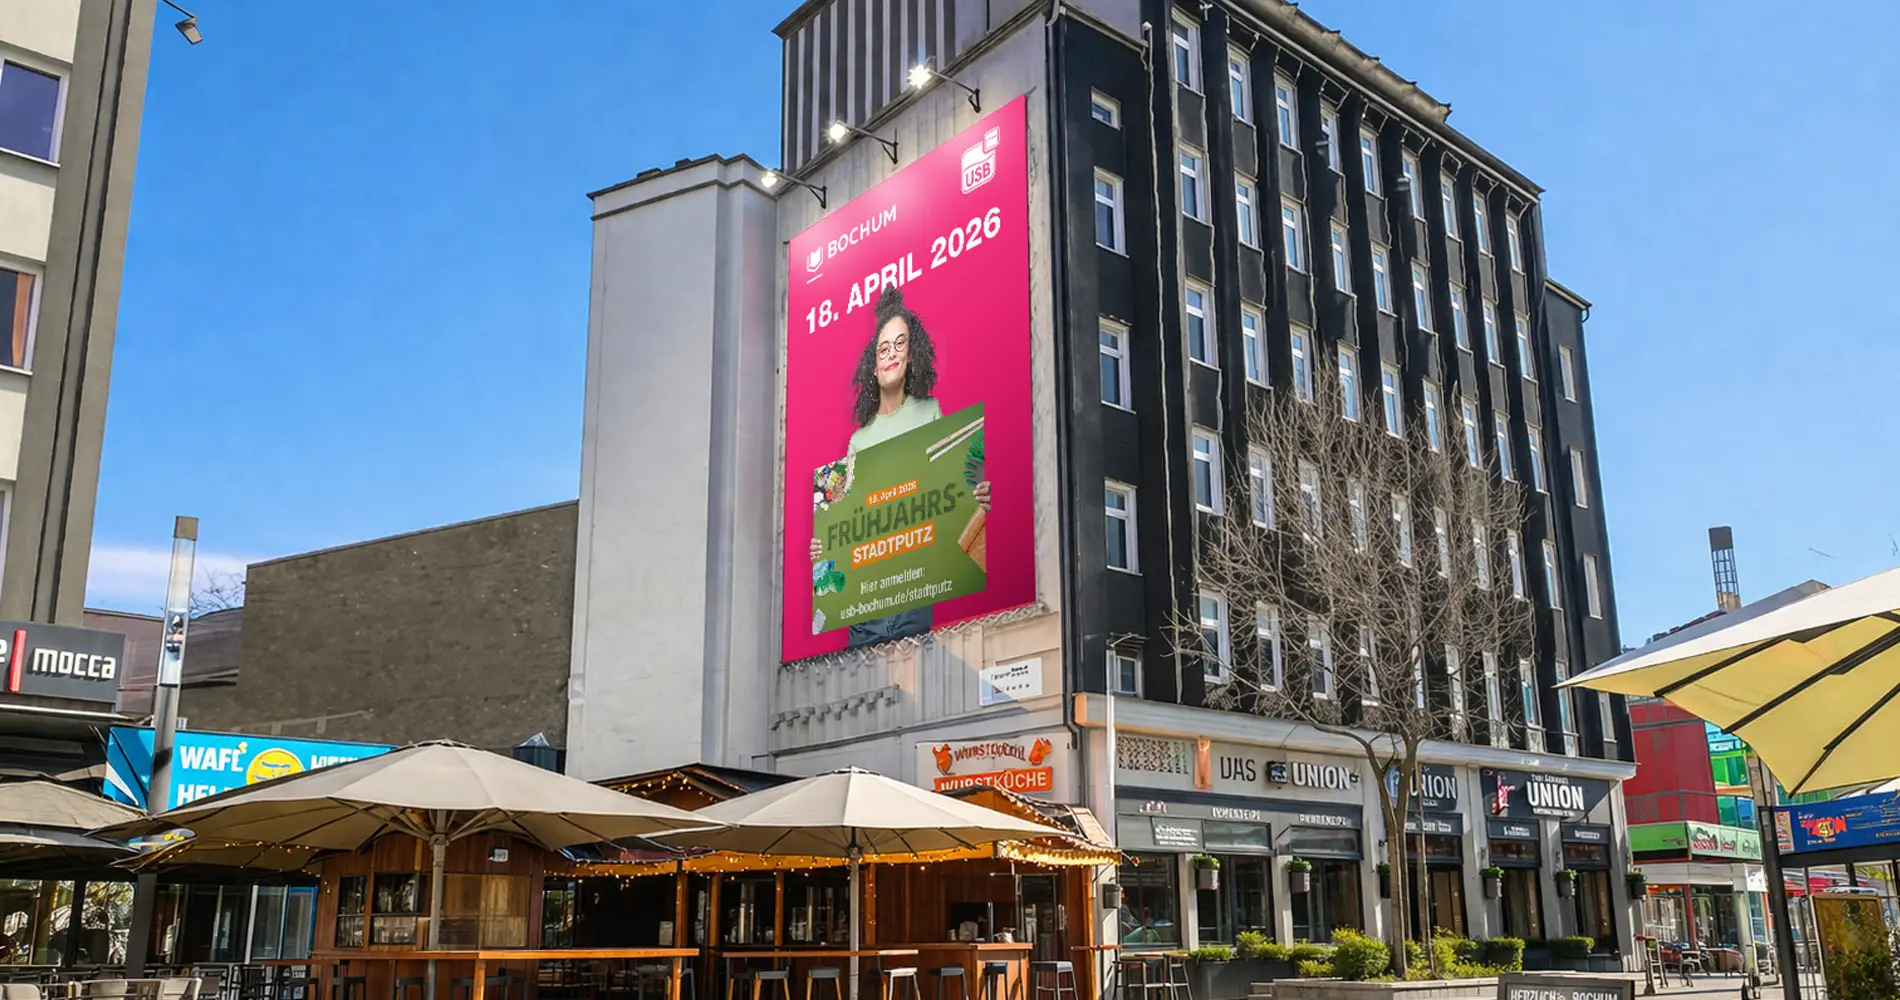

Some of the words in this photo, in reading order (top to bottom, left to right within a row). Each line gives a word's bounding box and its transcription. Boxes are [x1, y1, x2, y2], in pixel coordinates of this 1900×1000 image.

[965, 162, 991, 188] USB
[827, 204, 897, 259] BOCHUM
[805, 299, 839, 334] 18.
[846, 252, 922, 314] APRIL
[930, 206, 1001, 269] 2026
[827, 482, 965, 551] FRÜHJAHRS-
[853, 525, 933, 564] STADTPUTZ
[860, 580, 878, 595] Hier
[32, 647, 117, 680] mocca
[1291, 761, 1351, 790] UNION
[1526, 780, 1585, 811] UNION
